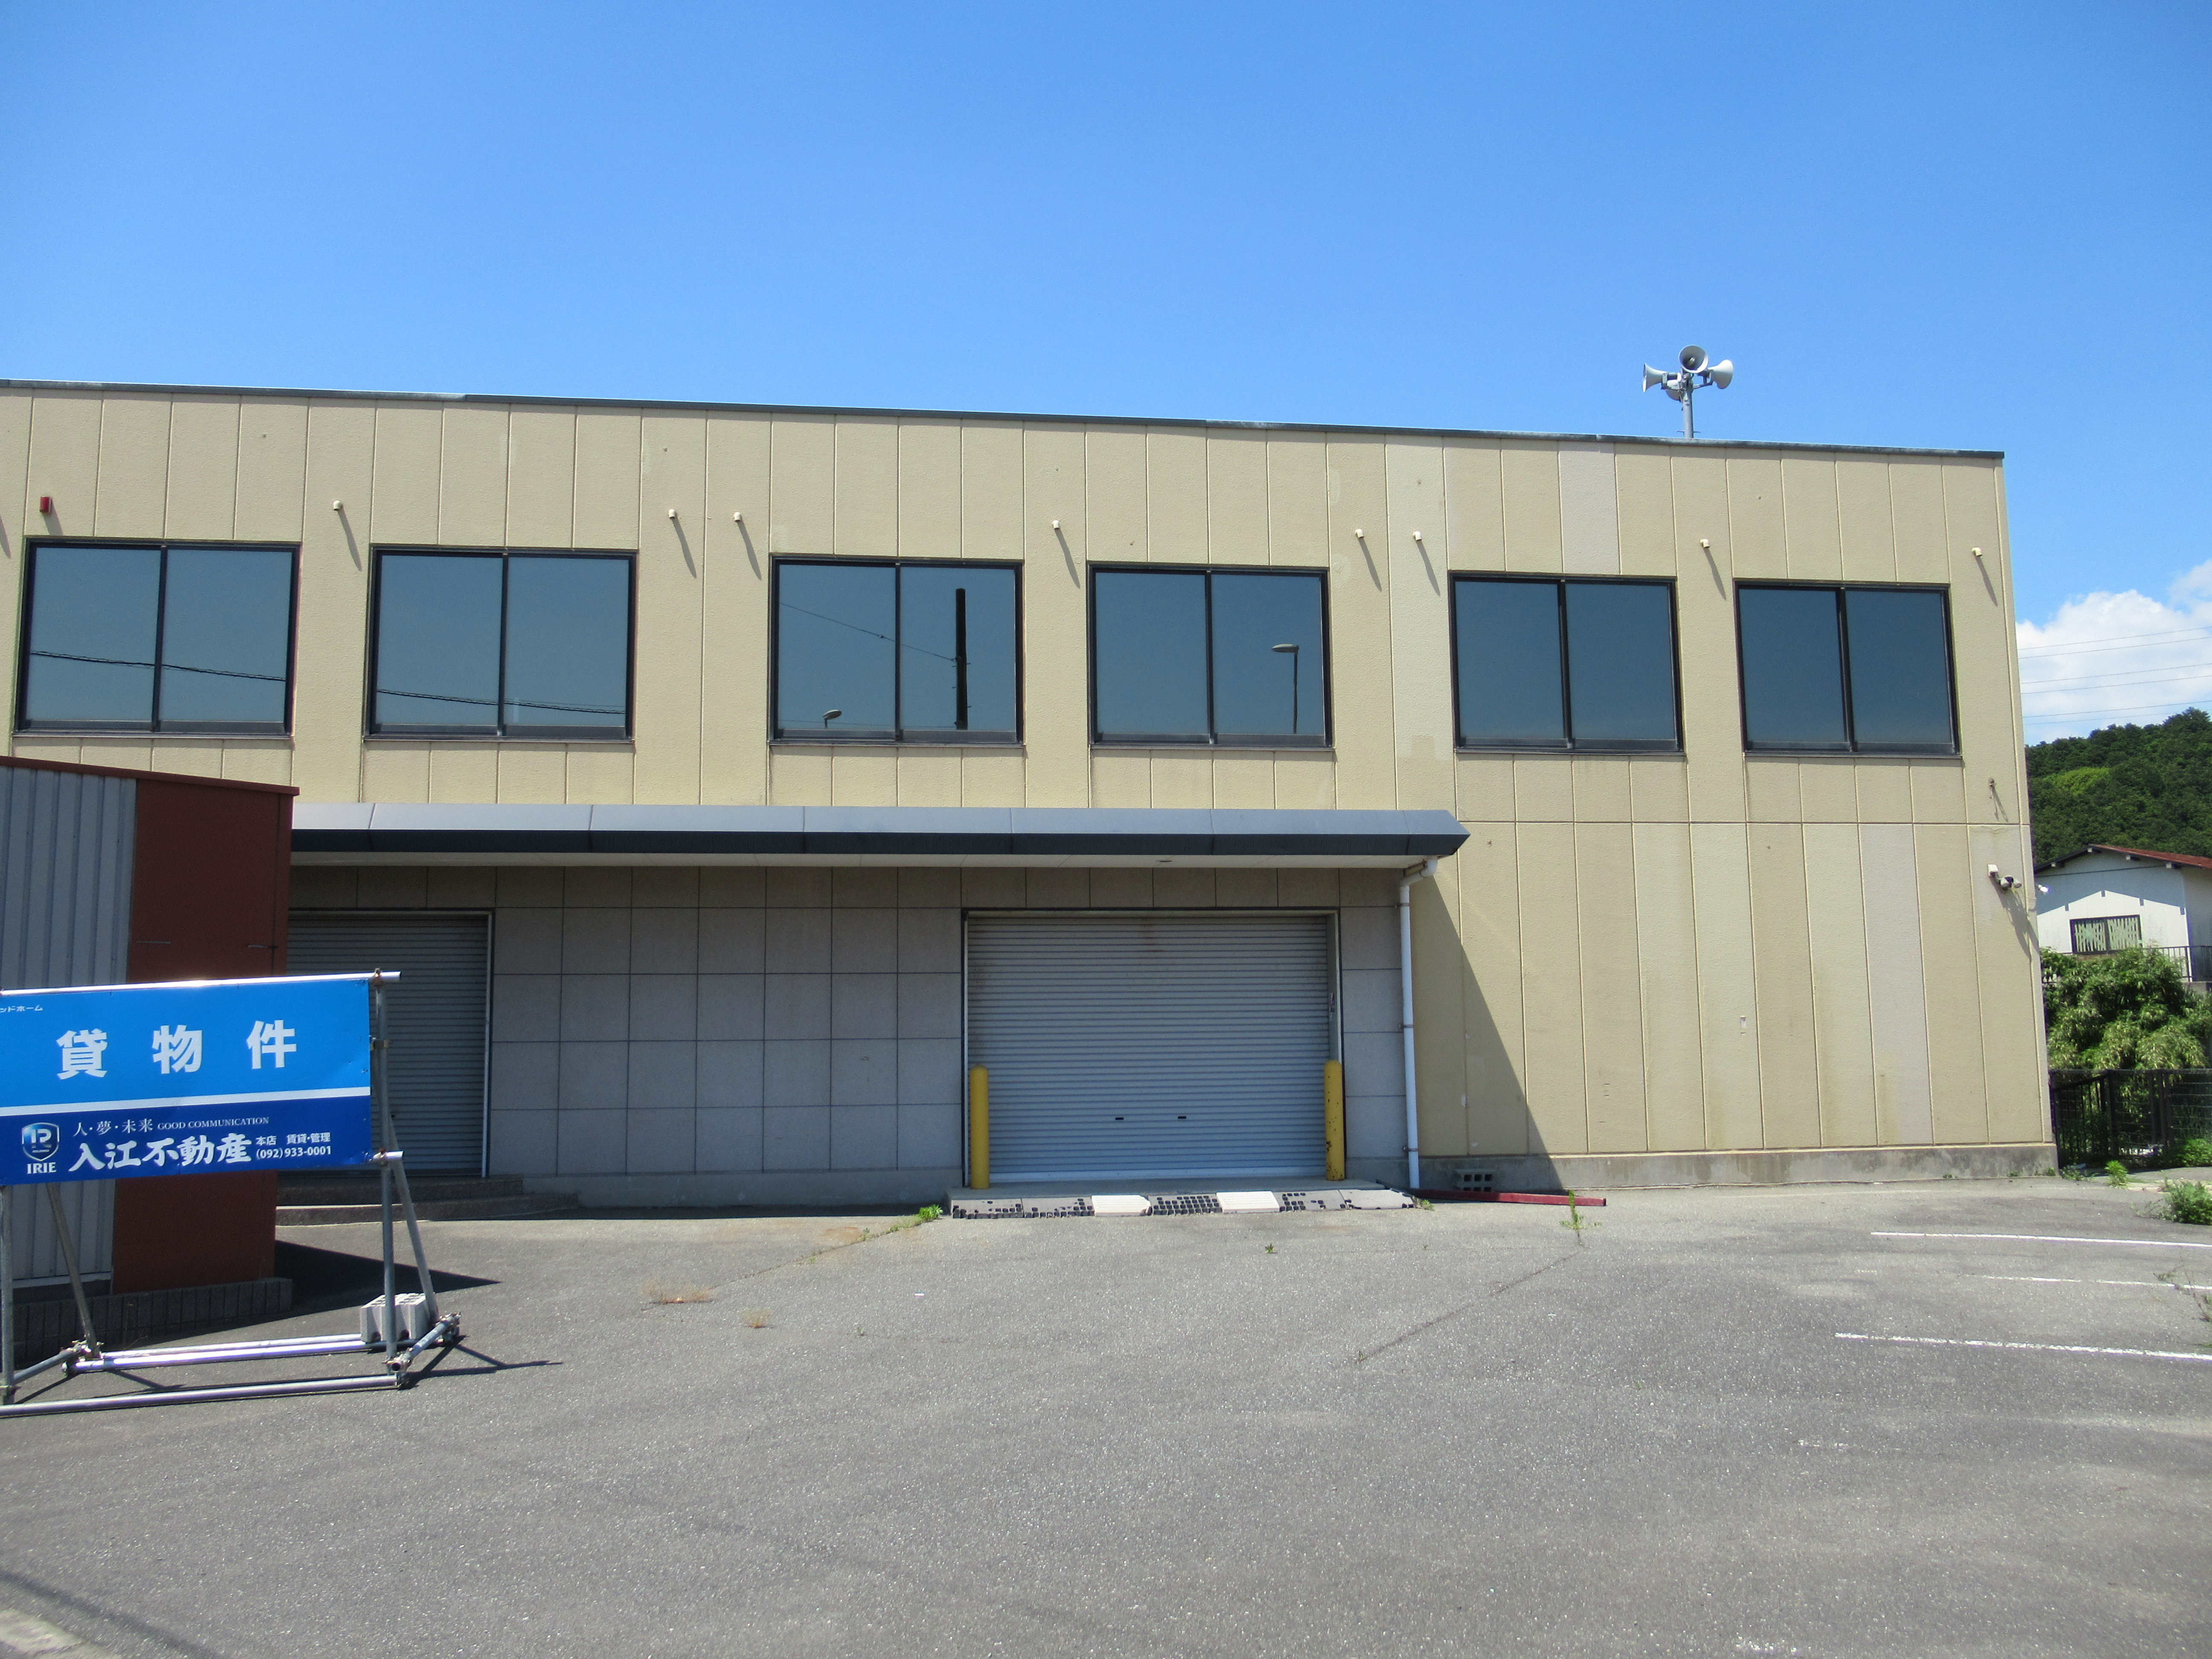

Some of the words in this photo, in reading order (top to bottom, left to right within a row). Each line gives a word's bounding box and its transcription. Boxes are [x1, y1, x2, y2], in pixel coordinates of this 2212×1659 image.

[56, 1019, 297, 1080] 貸物件
[158, 1121, 186, 1130] GOOD
[188, 1117, 270, 1128] COMMUNICATION
[256, 1136, 276, 1146] 本店
[68, 1133, 252, 1171] 入江不動産
[27, 1162, 57, 1174] IRIE
